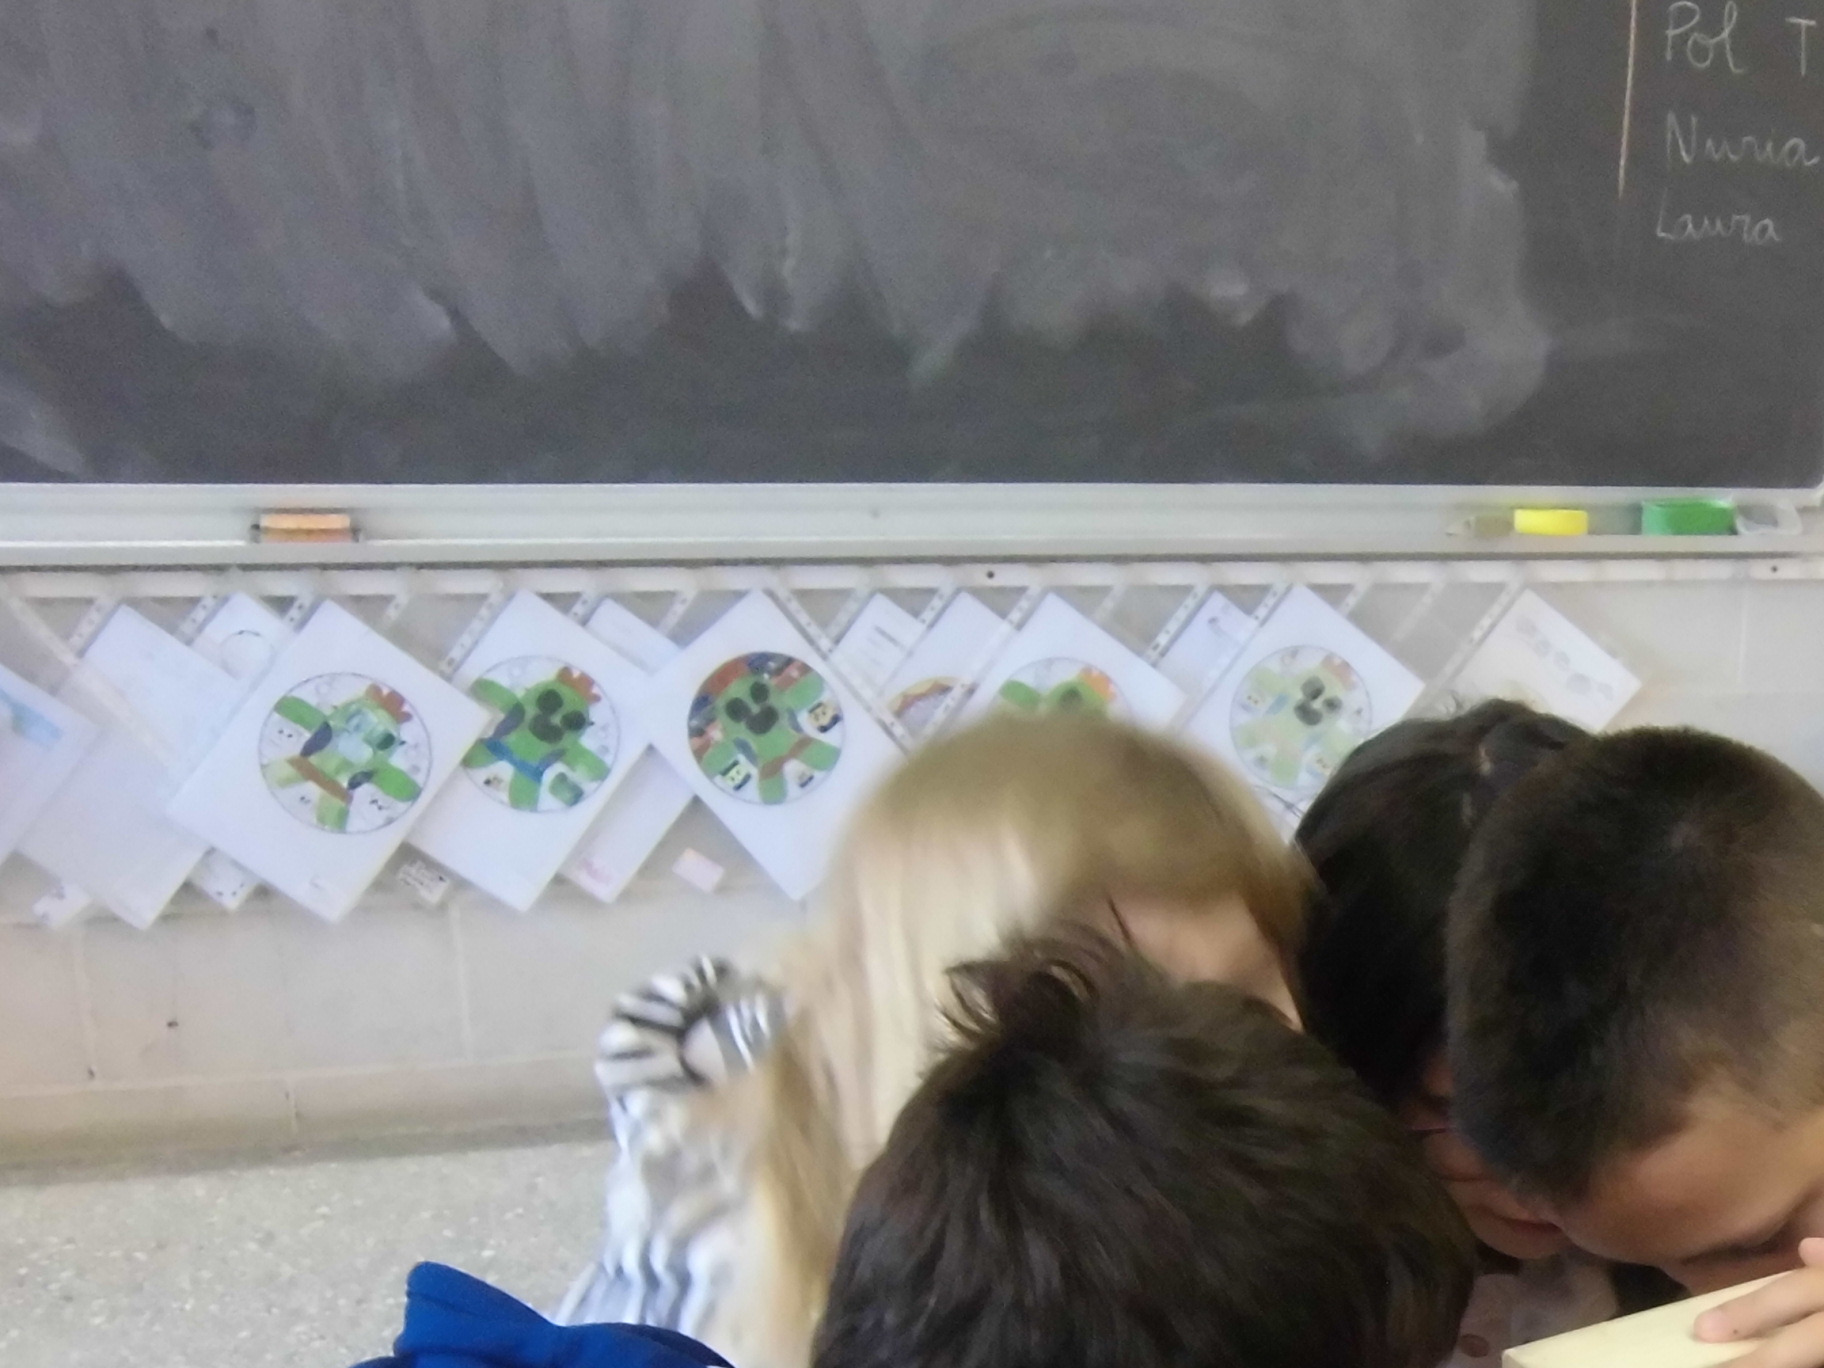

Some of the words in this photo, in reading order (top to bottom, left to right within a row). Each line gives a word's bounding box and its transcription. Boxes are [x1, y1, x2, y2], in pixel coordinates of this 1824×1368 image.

[1665, 0, 1746, 74] Pol
[1785, 16, 1817, 77] T
[1656, 187, 1783, 244] Laura
